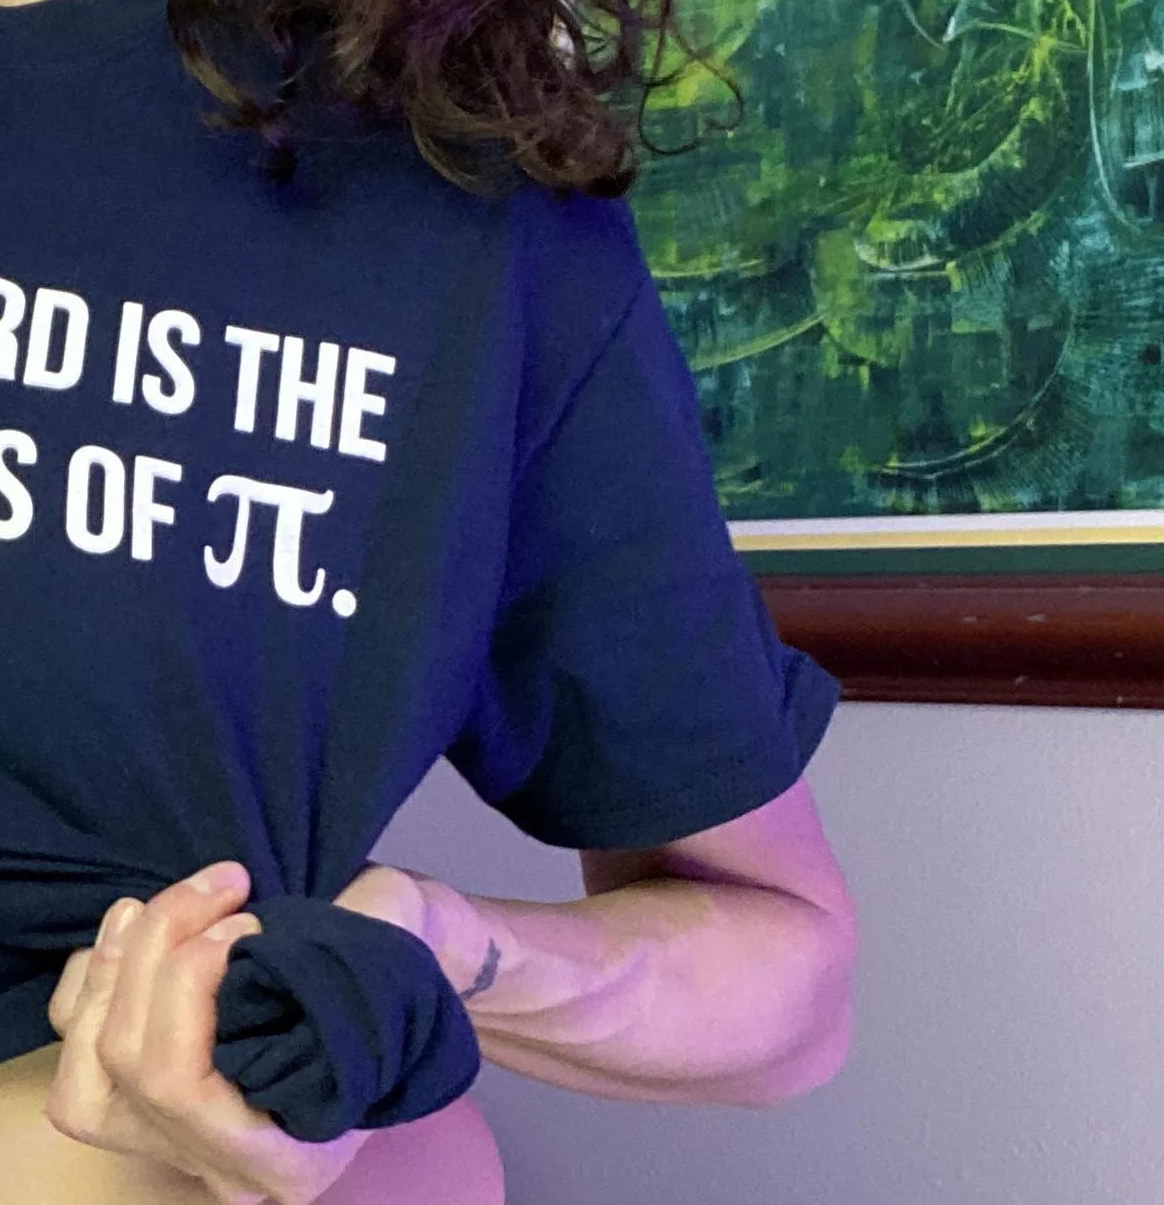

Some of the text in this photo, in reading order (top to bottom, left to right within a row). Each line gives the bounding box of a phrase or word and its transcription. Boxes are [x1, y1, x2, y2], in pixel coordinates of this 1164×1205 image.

[112, 301, 202, 415] IS
[224, 325, 398, 463] THE
[65, 444, 183, 561] OF
[203, 474, 358, 618] π.
